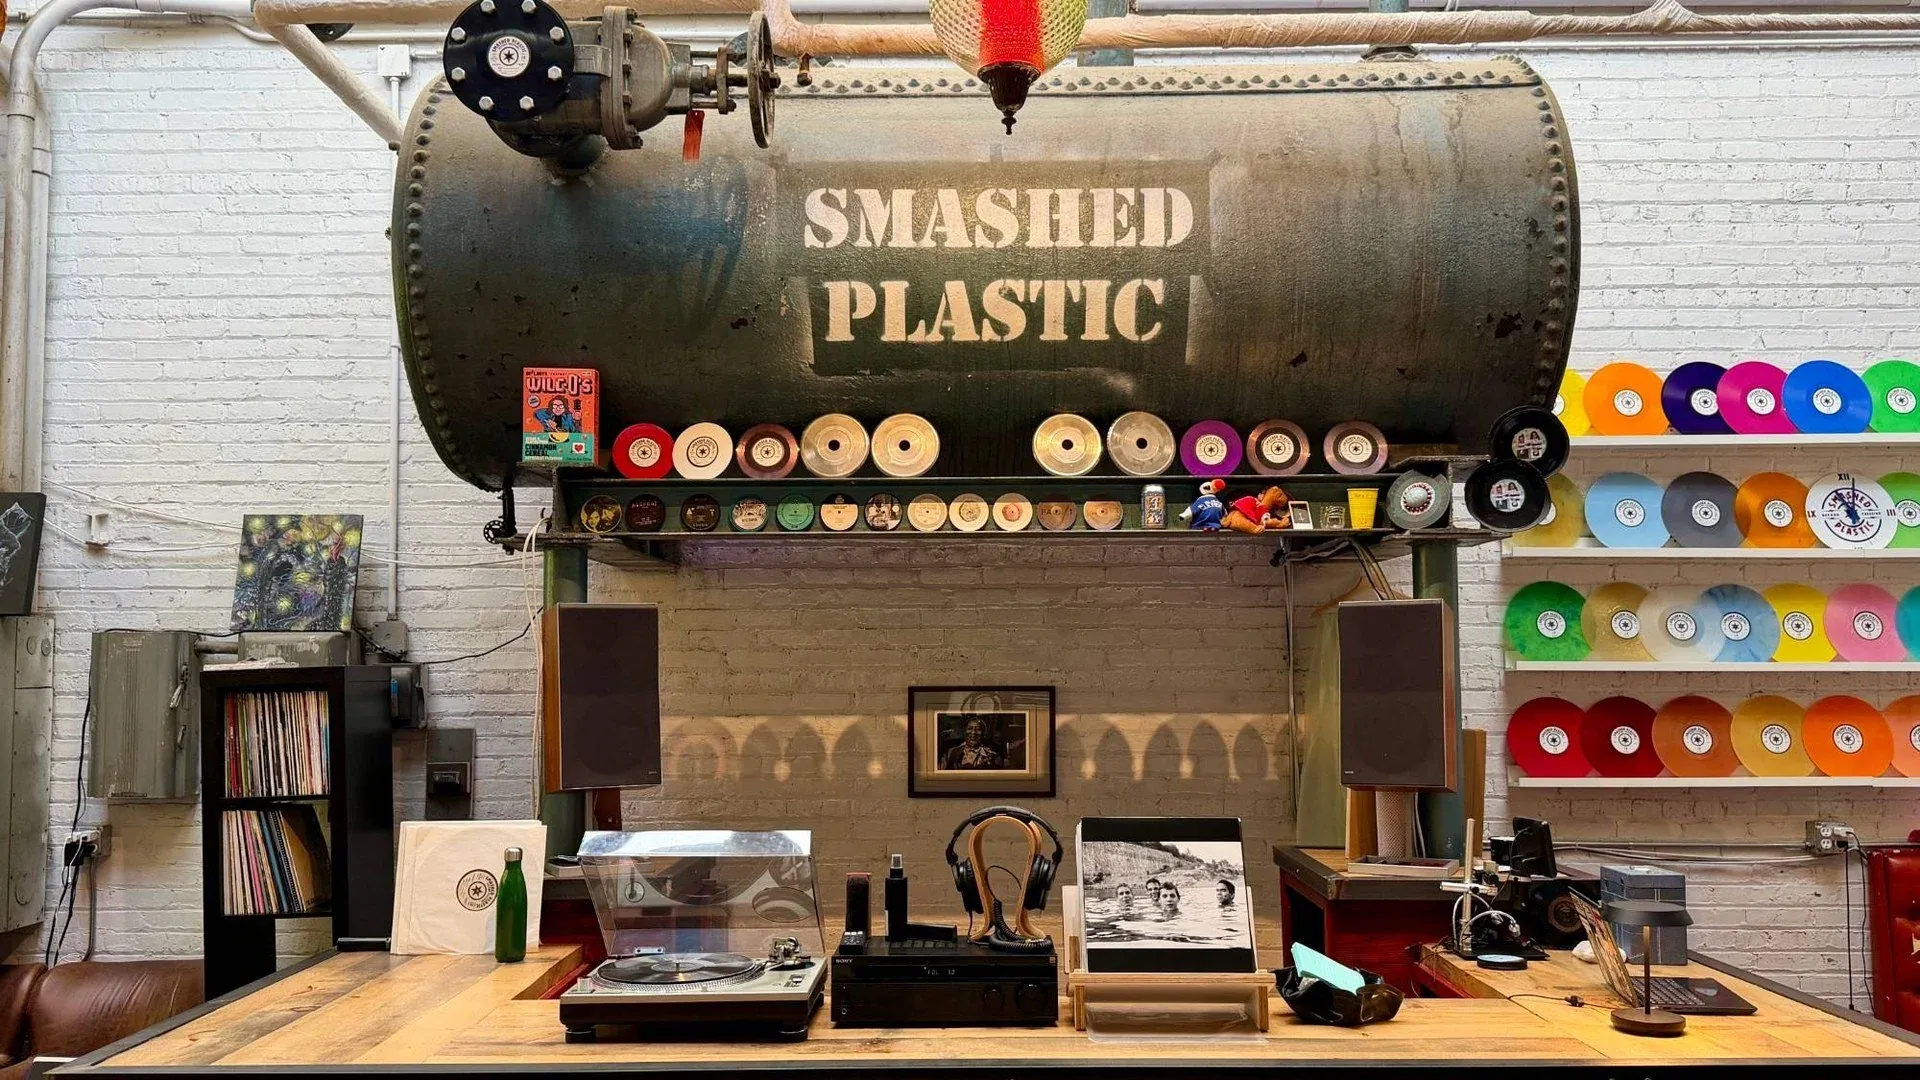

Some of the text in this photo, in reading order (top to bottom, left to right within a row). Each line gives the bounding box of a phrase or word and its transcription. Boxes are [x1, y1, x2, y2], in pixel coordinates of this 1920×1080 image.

[804, 187, 1194, 248] SMASHED
[824, 278, 1165, 342] PLASTIC
[1837, 473, 1850, 481] XII
[1807, 510, 1817, 518] IX
[1834, 520, 1874, 536] PLASTIC
